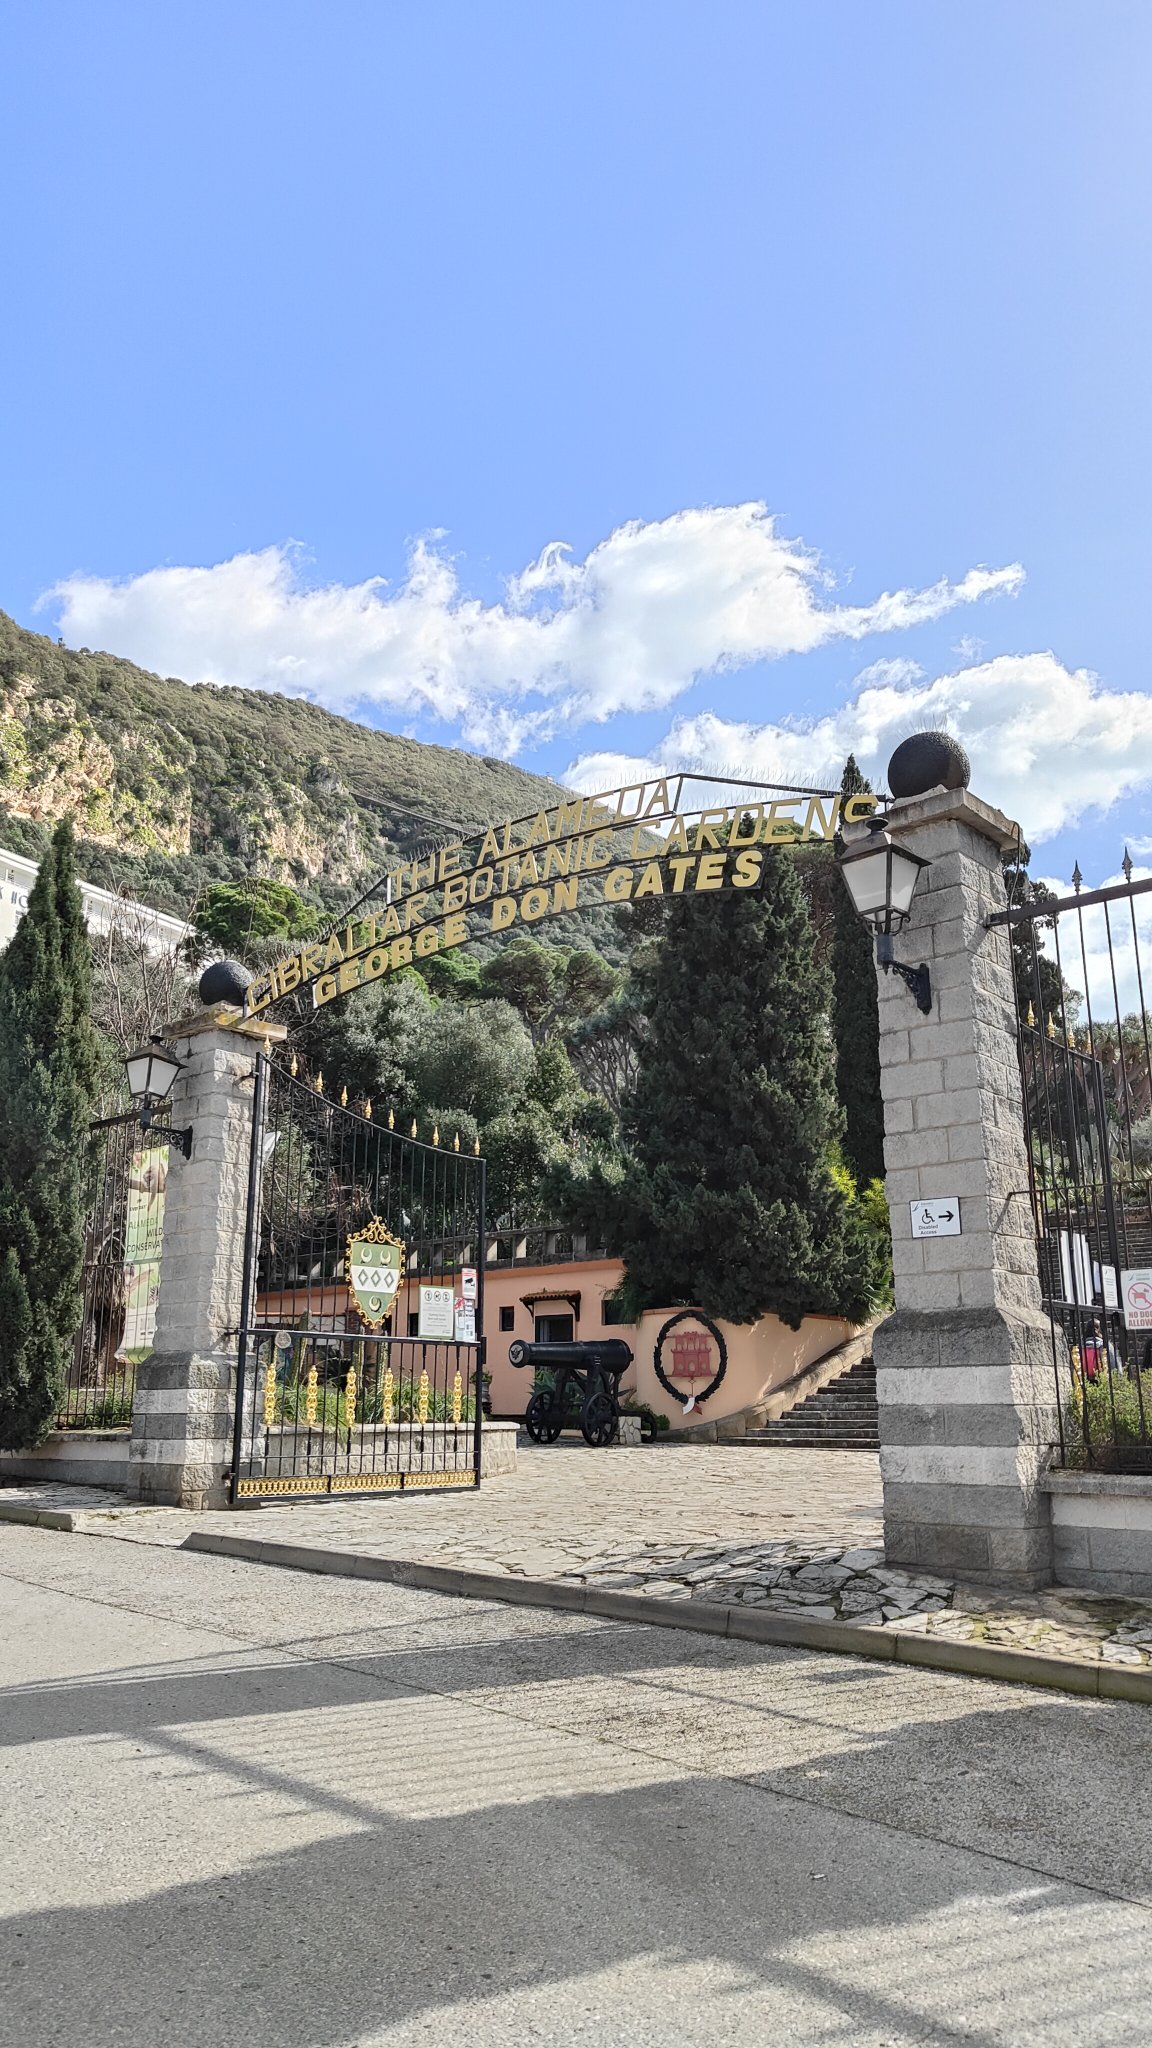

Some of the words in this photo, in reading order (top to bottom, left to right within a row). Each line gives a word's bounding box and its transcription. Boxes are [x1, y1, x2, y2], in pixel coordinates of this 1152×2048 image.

[389, 842, 463, 900] THE
[477, 779, 669, 866] ALAMEDA
[443, 828, 615, 914] BOTANIC
[315, 912, 467, 1006] GEORGE
[492, 876, 578, 931] DON
[604, 849, 764, 900] GATES
[147, 1227, 163, 1237] WILD
